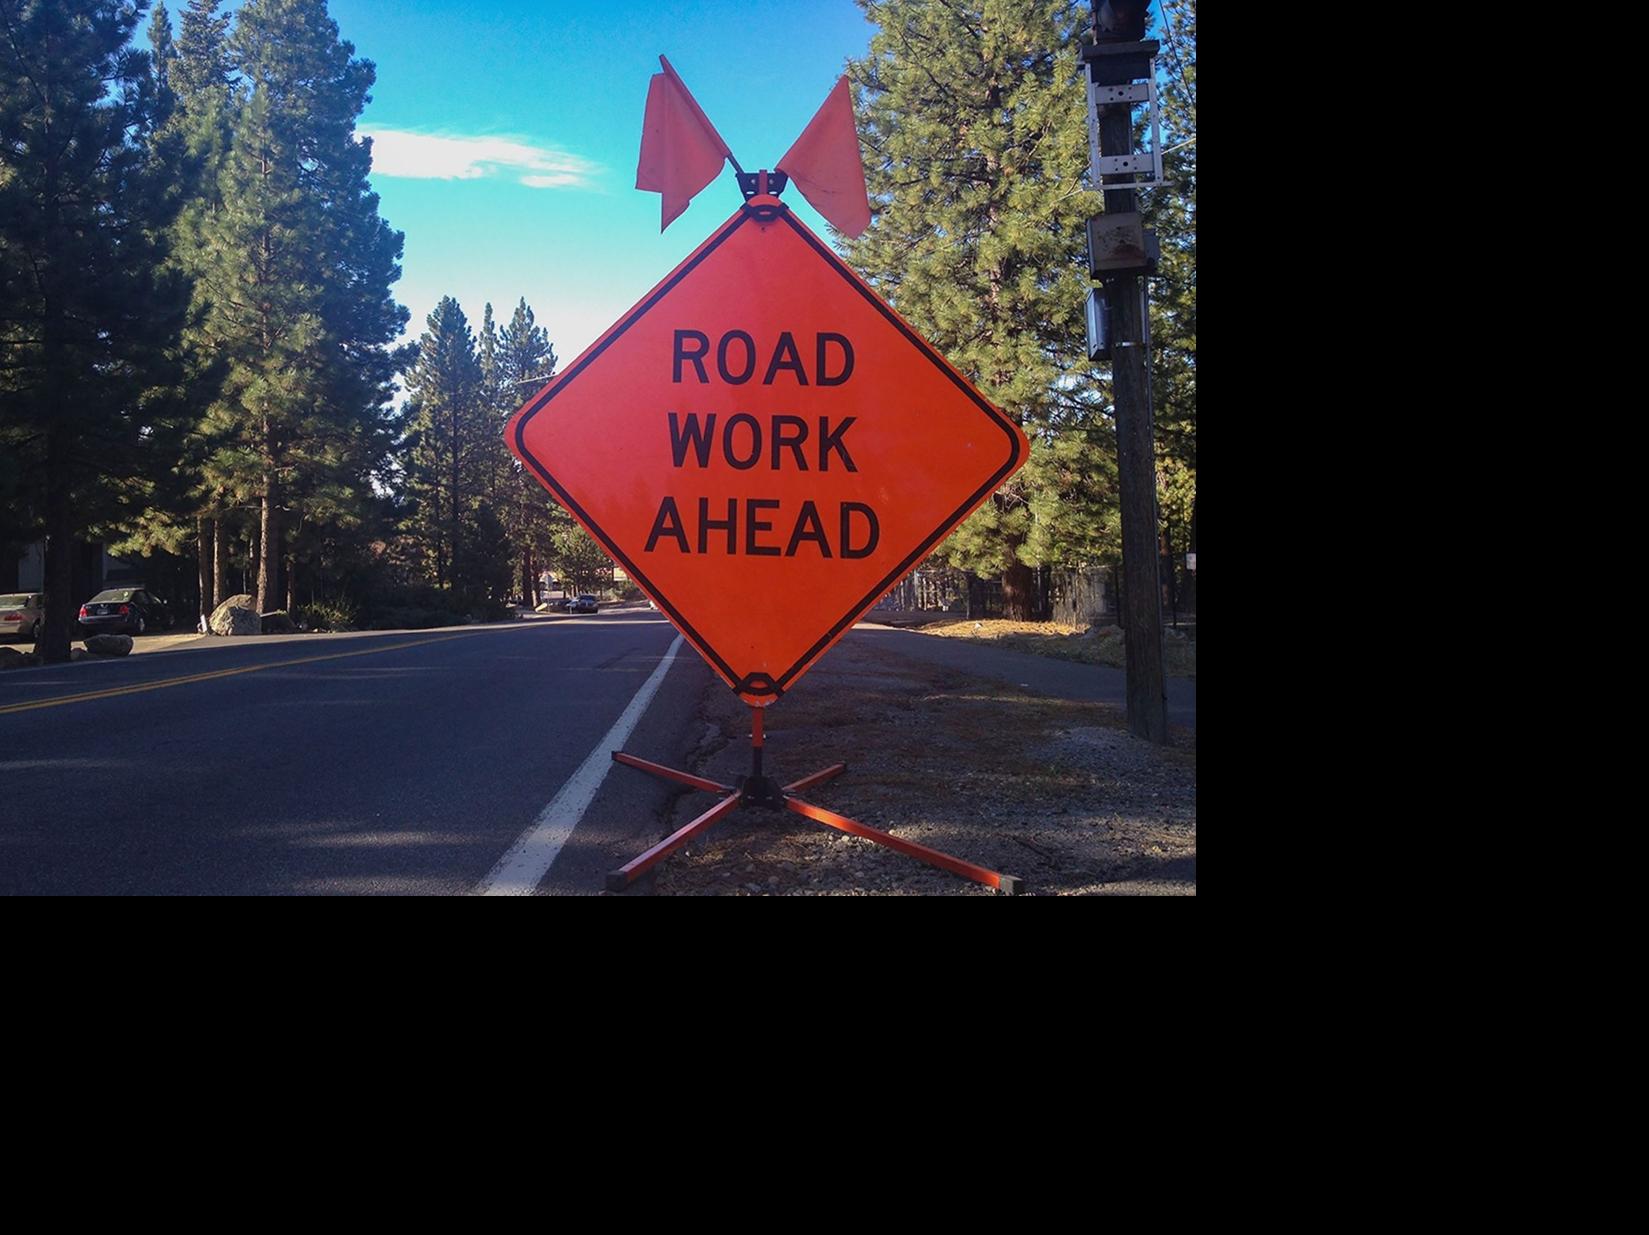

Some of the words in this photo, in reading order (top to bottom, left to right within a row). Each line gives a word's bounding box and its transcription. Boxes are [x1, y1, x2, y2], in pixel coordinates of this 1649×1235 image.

[672, 329, 855, 387] ROAD
[667, 412, 859, 473] WORK
[643, 495, 881, 560] AHEAD
